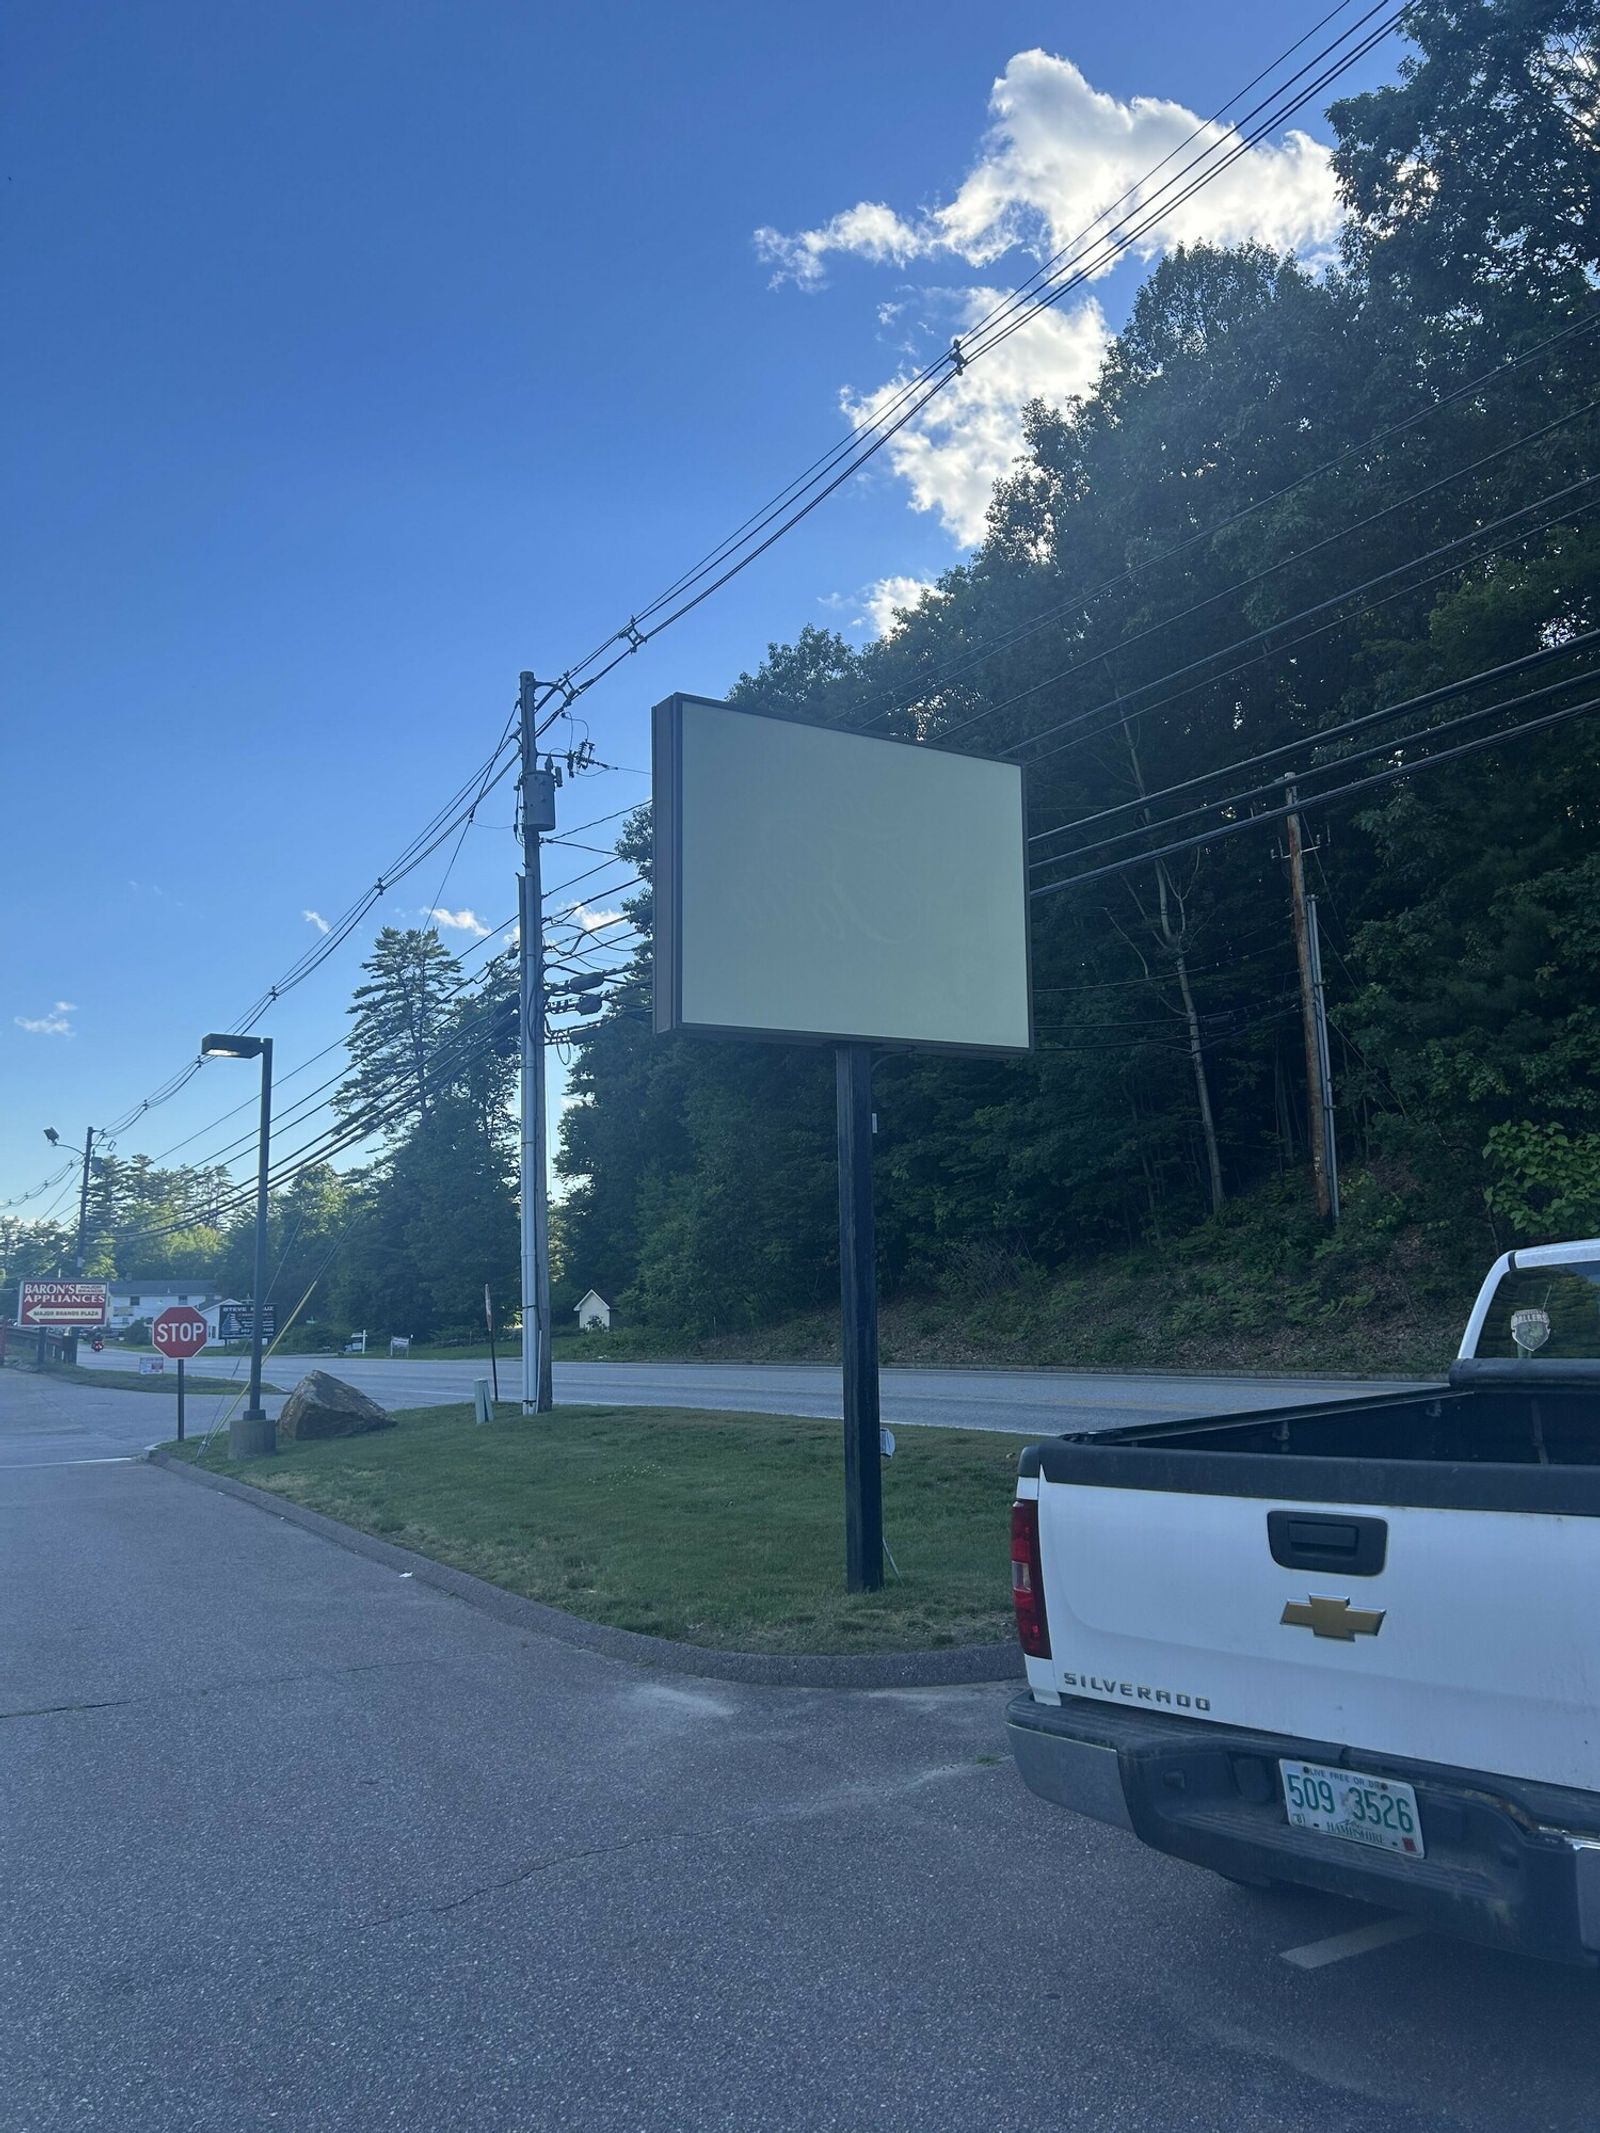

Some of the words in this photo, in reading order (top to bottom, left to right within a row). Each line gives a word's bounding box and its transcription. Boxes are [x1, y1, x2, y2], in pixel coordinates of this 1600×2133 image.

[24, 1284, 75, 1295] BARON'S
[24, 1294, 105, 1303] APPLIANCES
[156, 1322, 204, 1343] STOP
[1063, 1672, 1211, 1712] SILVERADO
[1309, 1769, 1326, 1778] LIVE
[1329, 1771, 1350, 1783] FREE
[1353, 1776, 1365, 1786] OR
[1286, 1773, 1336, 1814] 509
[1348, 1786, 1414, 1833] 3526
[1326, 1821, 1384, 1844] HAMPSHIRE
